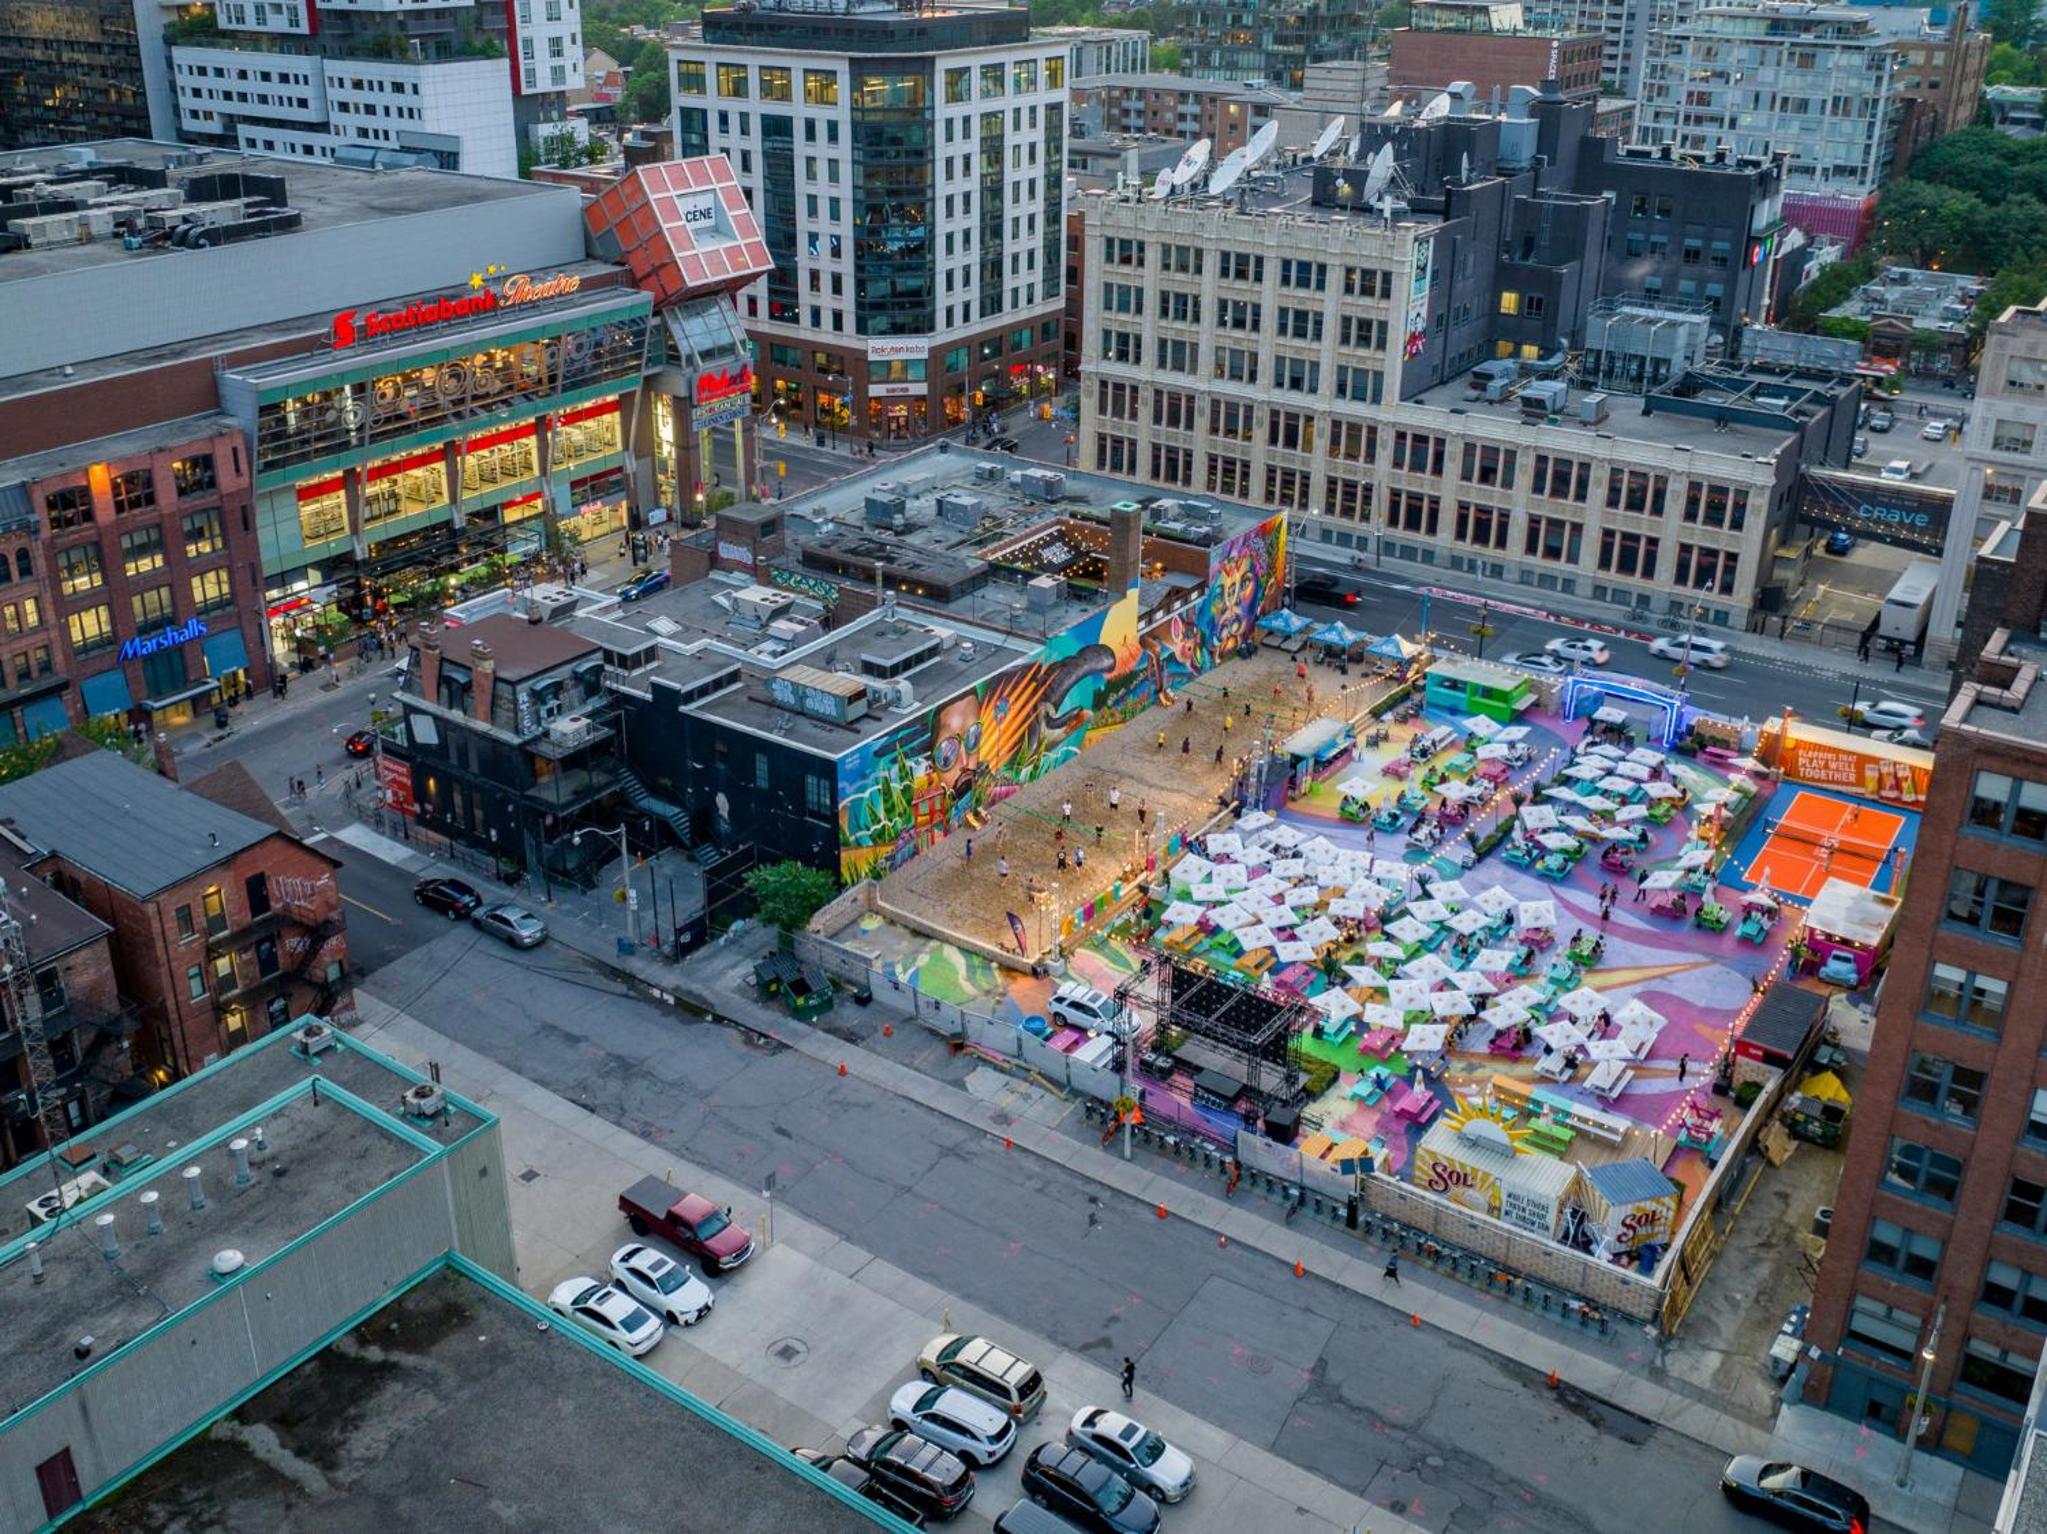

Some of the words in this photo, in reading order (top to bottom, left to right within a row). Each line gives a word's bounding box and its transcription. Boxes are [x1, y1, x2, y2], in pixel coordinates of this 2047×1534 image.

[364, 288, 498, 337] Scotiabank
[500, 274, 580, 307] Theatre
[119, 617, 208, 663] Marshalls
[1799, 757, 1824, 769] PLAY
[1828, 760, 1856, 772] WELL
[1799, 768, 1856, 784] TOGETHER
